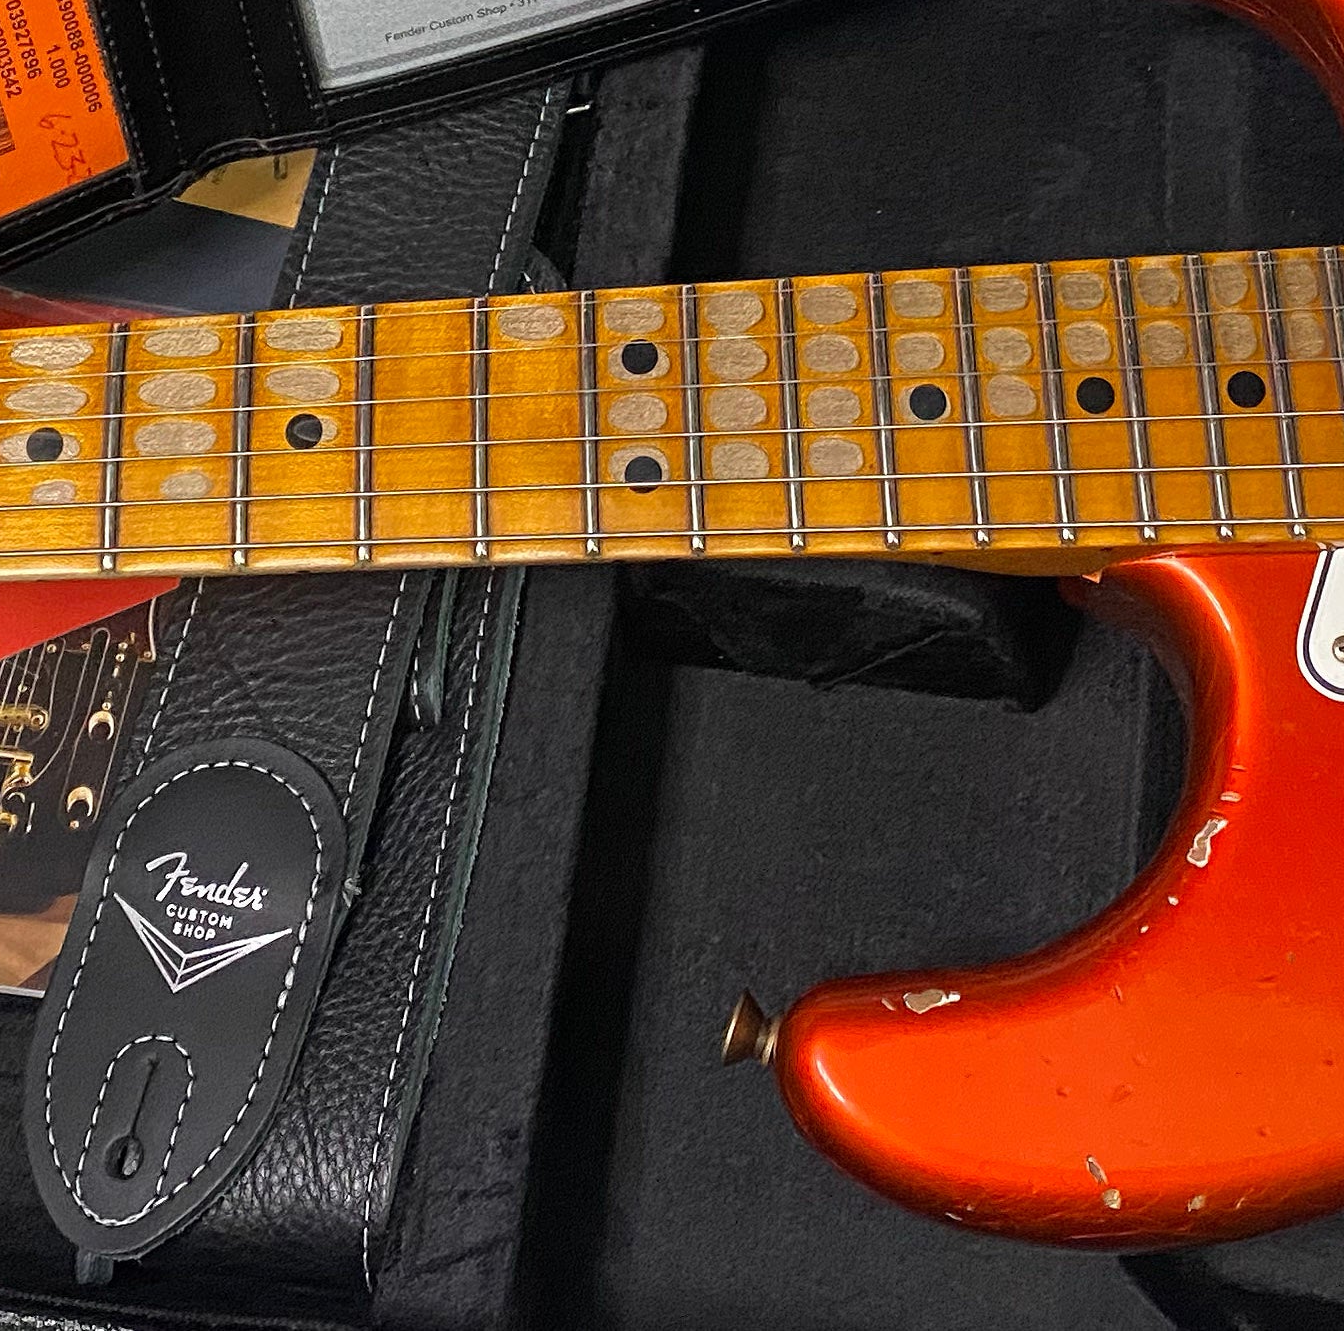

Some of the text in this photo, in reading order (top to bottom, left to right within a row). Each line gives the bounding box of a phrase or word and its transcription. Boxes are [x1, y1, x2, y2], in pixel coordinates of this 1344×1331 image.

[429, 13, 474, 31] Custom
[476, 4, 508, 19] Shop
[46, 44, 71, 89] 1.000
[145, 852, 266, 910] Fender
[166, 904, 234, 929] CUSTOM
[172, 921, 216, 940] SHOP
